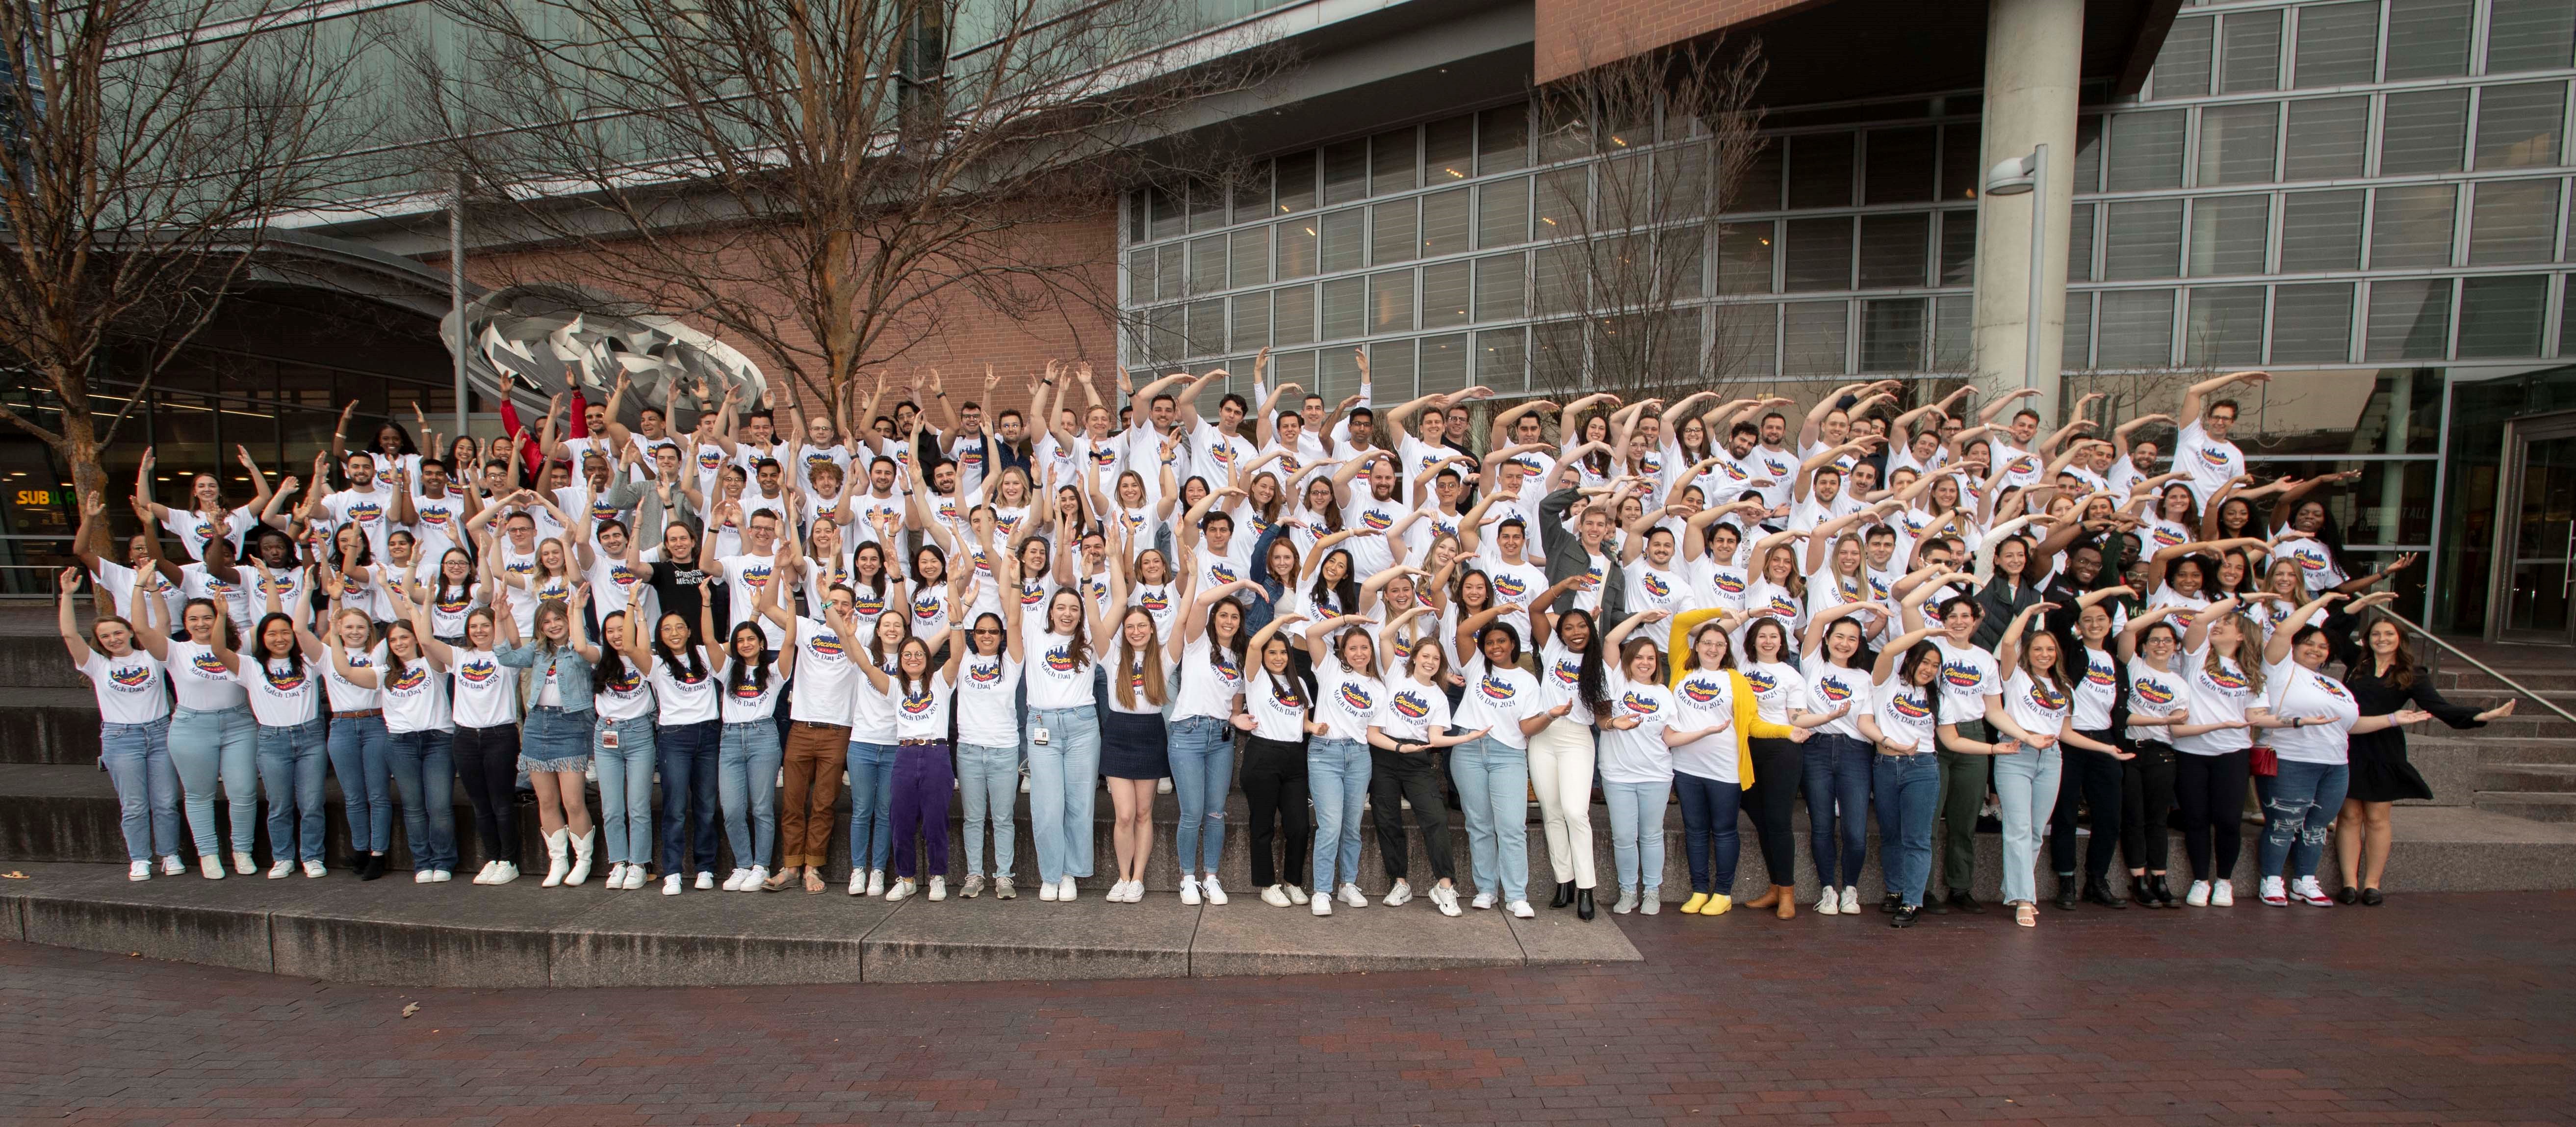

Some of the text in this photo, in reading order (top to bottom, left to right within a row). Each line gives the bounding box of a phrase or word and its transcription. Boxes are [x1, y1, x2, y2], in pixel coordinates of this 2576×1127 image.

[16, 491, 76, 504] SUBWA
[1246, 521, 1256, 535] Match
[1305, 529, 1315, 544] Match
[609, 577, 622, 590] Match
[739, 578, 750, 591] Match
[1207, 572, 1217, 586] Match
[1715, 577, 1745, 589] Cincinnati
[1310, 602, 1319, 618] Match
[1778, 617, 1790, 626] Day
[812, 638, 843, 649] Cincinna
[806, 644, 819, 658] Match
[190, 667, 210, 679] Match
[1041, 661, 1055, 678] Match
[1944, 668, 1981, 681] Cincinnati
[674, 681, 692, 692] Match
[964, 675, 975, 688] Match
[1220, 677, 1231, 687] Day
[1483, 679, 1515, 696] Cincinnati
[1556, 680, 1565, 691] Day
[2199, 675, 2216, 691] Match
[263, 685, 283, 698] Match
[1686, 683, 1718, 695] Cincinnati
[1955, 688, 1968, 696] Day
[1334, 690, 1344, 708] Match
[1345, 706, 1357, 717] Day
[1395, 696, 1427, 716] Cincinnati
[1485, 700, 1496, 708] Day
[1677, 690, 1724, 711] Match Day 2024
[1895, 697, 1930, 713] Cincinnati
[2022, 695, 2037, 712] Match
[2039, 709, 2052, 719] Day
[1267, 698, 1283, 713] Match
[1285, 708, 1296, 717] Day
[1618, 701, 1629, 715] Match
[1887, 702, 1899, 719] Match
[1901, 717, 1915, 726] Day
[899, 708, 913, 721] Match
[1401, 715, 1413, 725] Day
